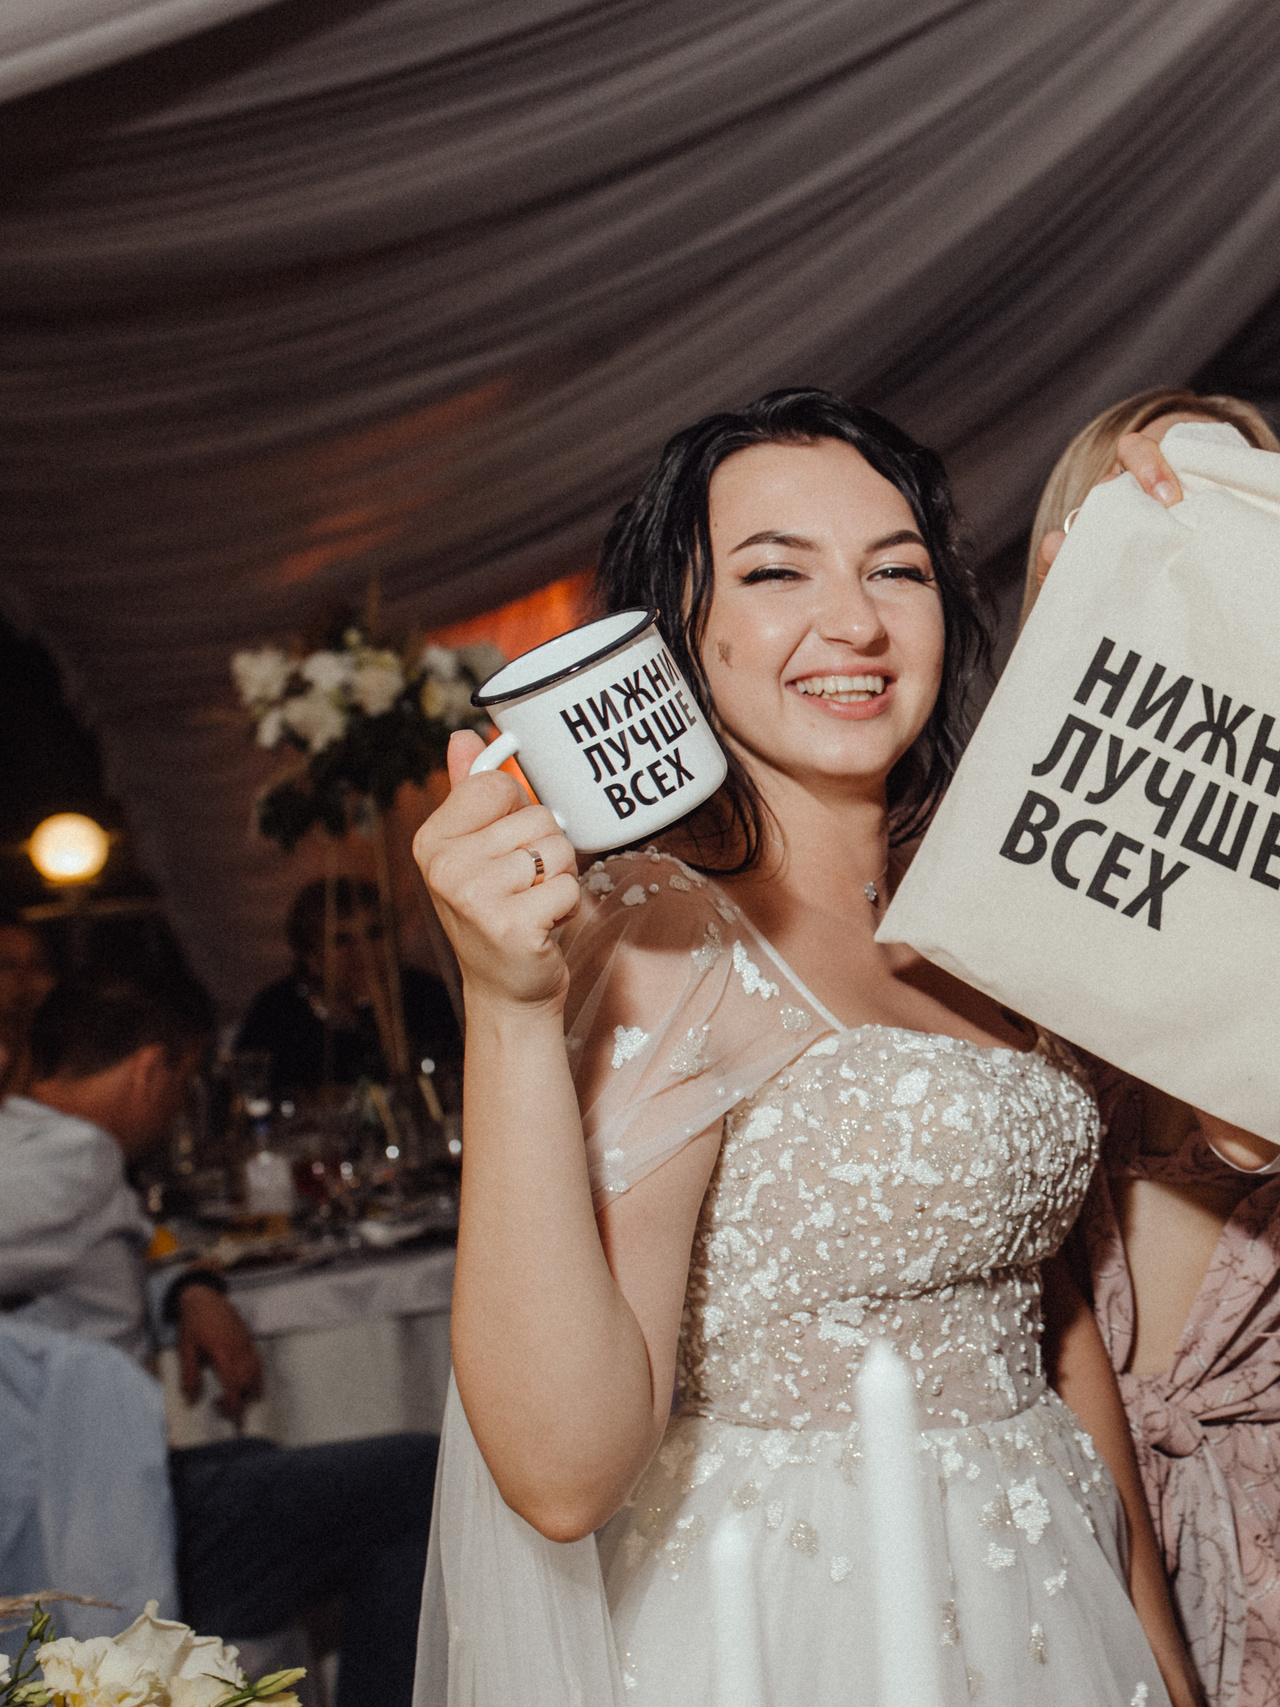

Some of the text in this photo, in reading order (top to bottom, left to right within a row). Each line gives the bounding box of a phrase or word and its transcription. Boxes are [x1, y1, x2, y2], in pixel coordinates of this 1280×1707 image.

[582, 690, 697, 784] ЛУЧШЕ
[603, 747, 695, 820] ВСЕХ
[999, 789, 1191, 931] ВСЕХ
